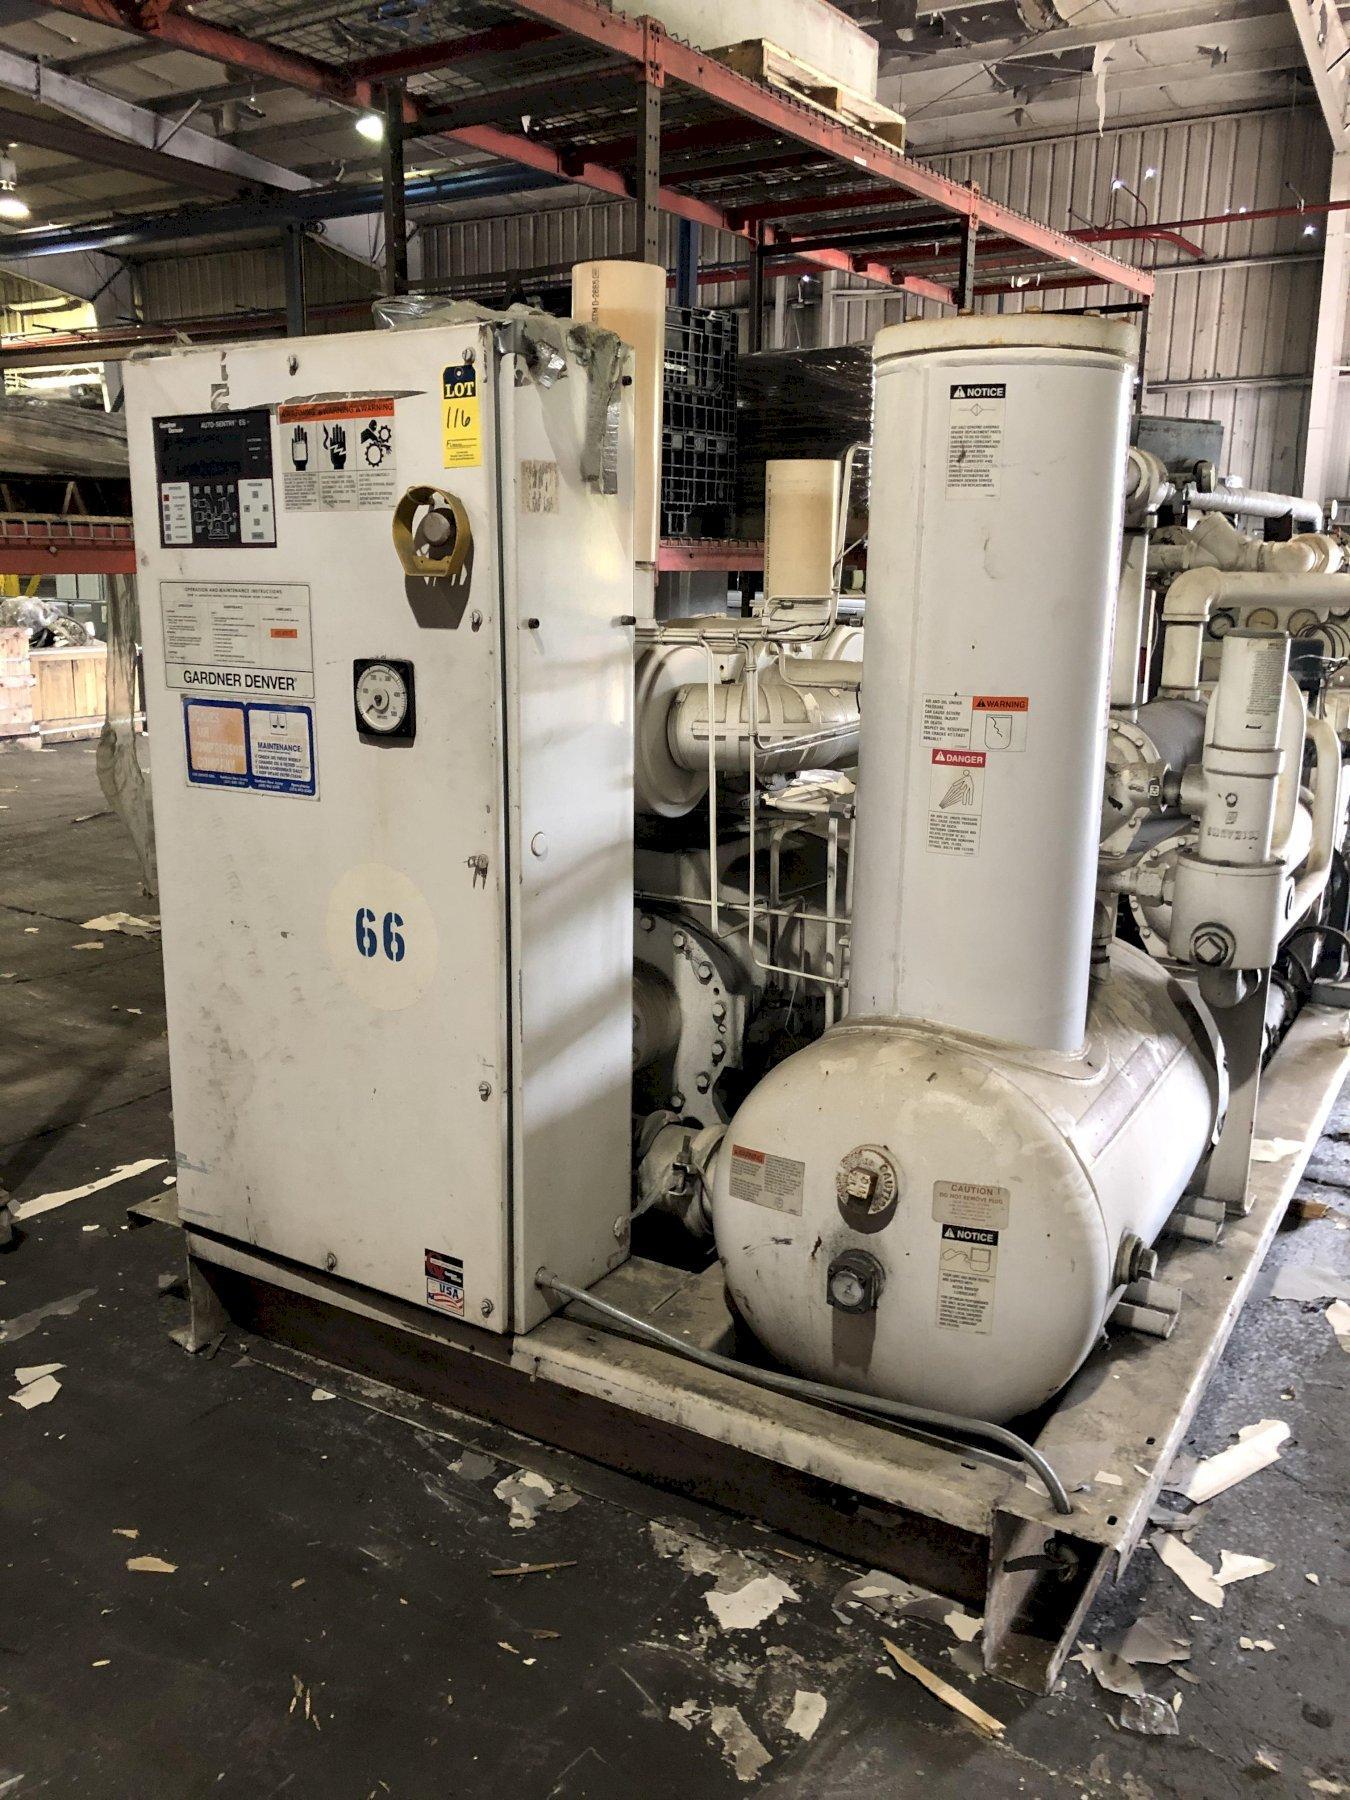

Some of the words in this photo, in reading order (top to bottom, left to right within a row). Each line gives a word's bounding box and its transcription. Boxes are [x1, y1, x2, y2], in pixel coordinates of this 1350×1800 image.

[445, 382, 474, 398] LOT
[967, 388, 1003, 397] NOTICE
[362, 402, 393, 412] WARNING
[447, 406, 471, 428] 116
[184, 670, 241, 686] GARDNER
[246, 674, 295, 691] DENVER
[987, 700, 1026, 709] WARNING
[946, 754, 983, 764] DANGER
[356, 908, 405, 962] 66
[952, 1184, 993, 1196] CAUTION
[964, 1195, 987, 1203] REMOVE
[989, 1197, 1003, 1205] PLUG
[957, 1230, 994, 1243] NOTICE
[440, 1283, 459, 1299] USA
